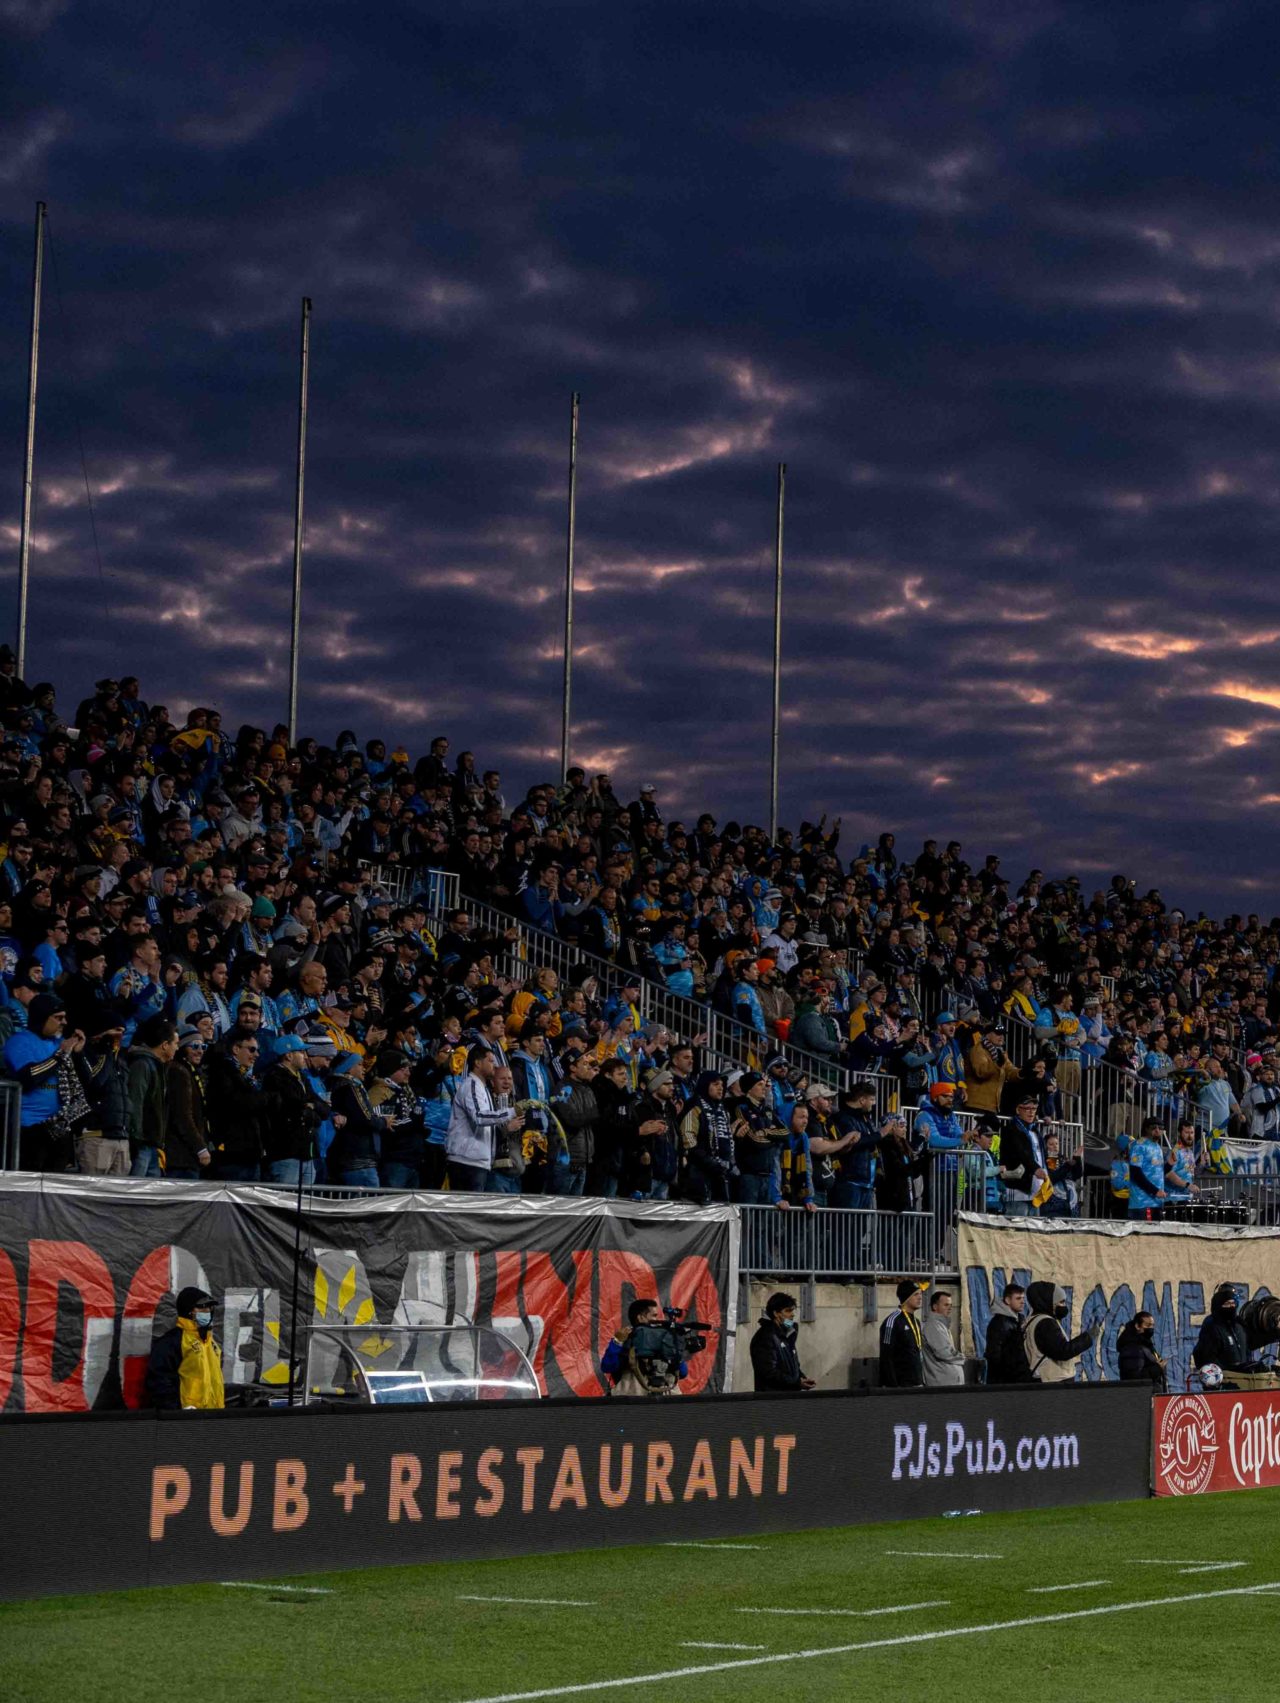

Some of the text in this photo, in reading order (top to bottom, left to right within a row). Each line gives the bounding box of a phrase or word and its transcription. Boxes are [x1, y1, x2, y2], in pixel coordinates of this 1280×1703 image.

[1166, 1400, 1185, 1433] CAPTAIN
[891, 1419, 1080, 1480] PJsPub.com
[150, 1434, 796, 1541] PUB + RESTAURANT
[1186, 1459, 1209, 1491] COMPANY
